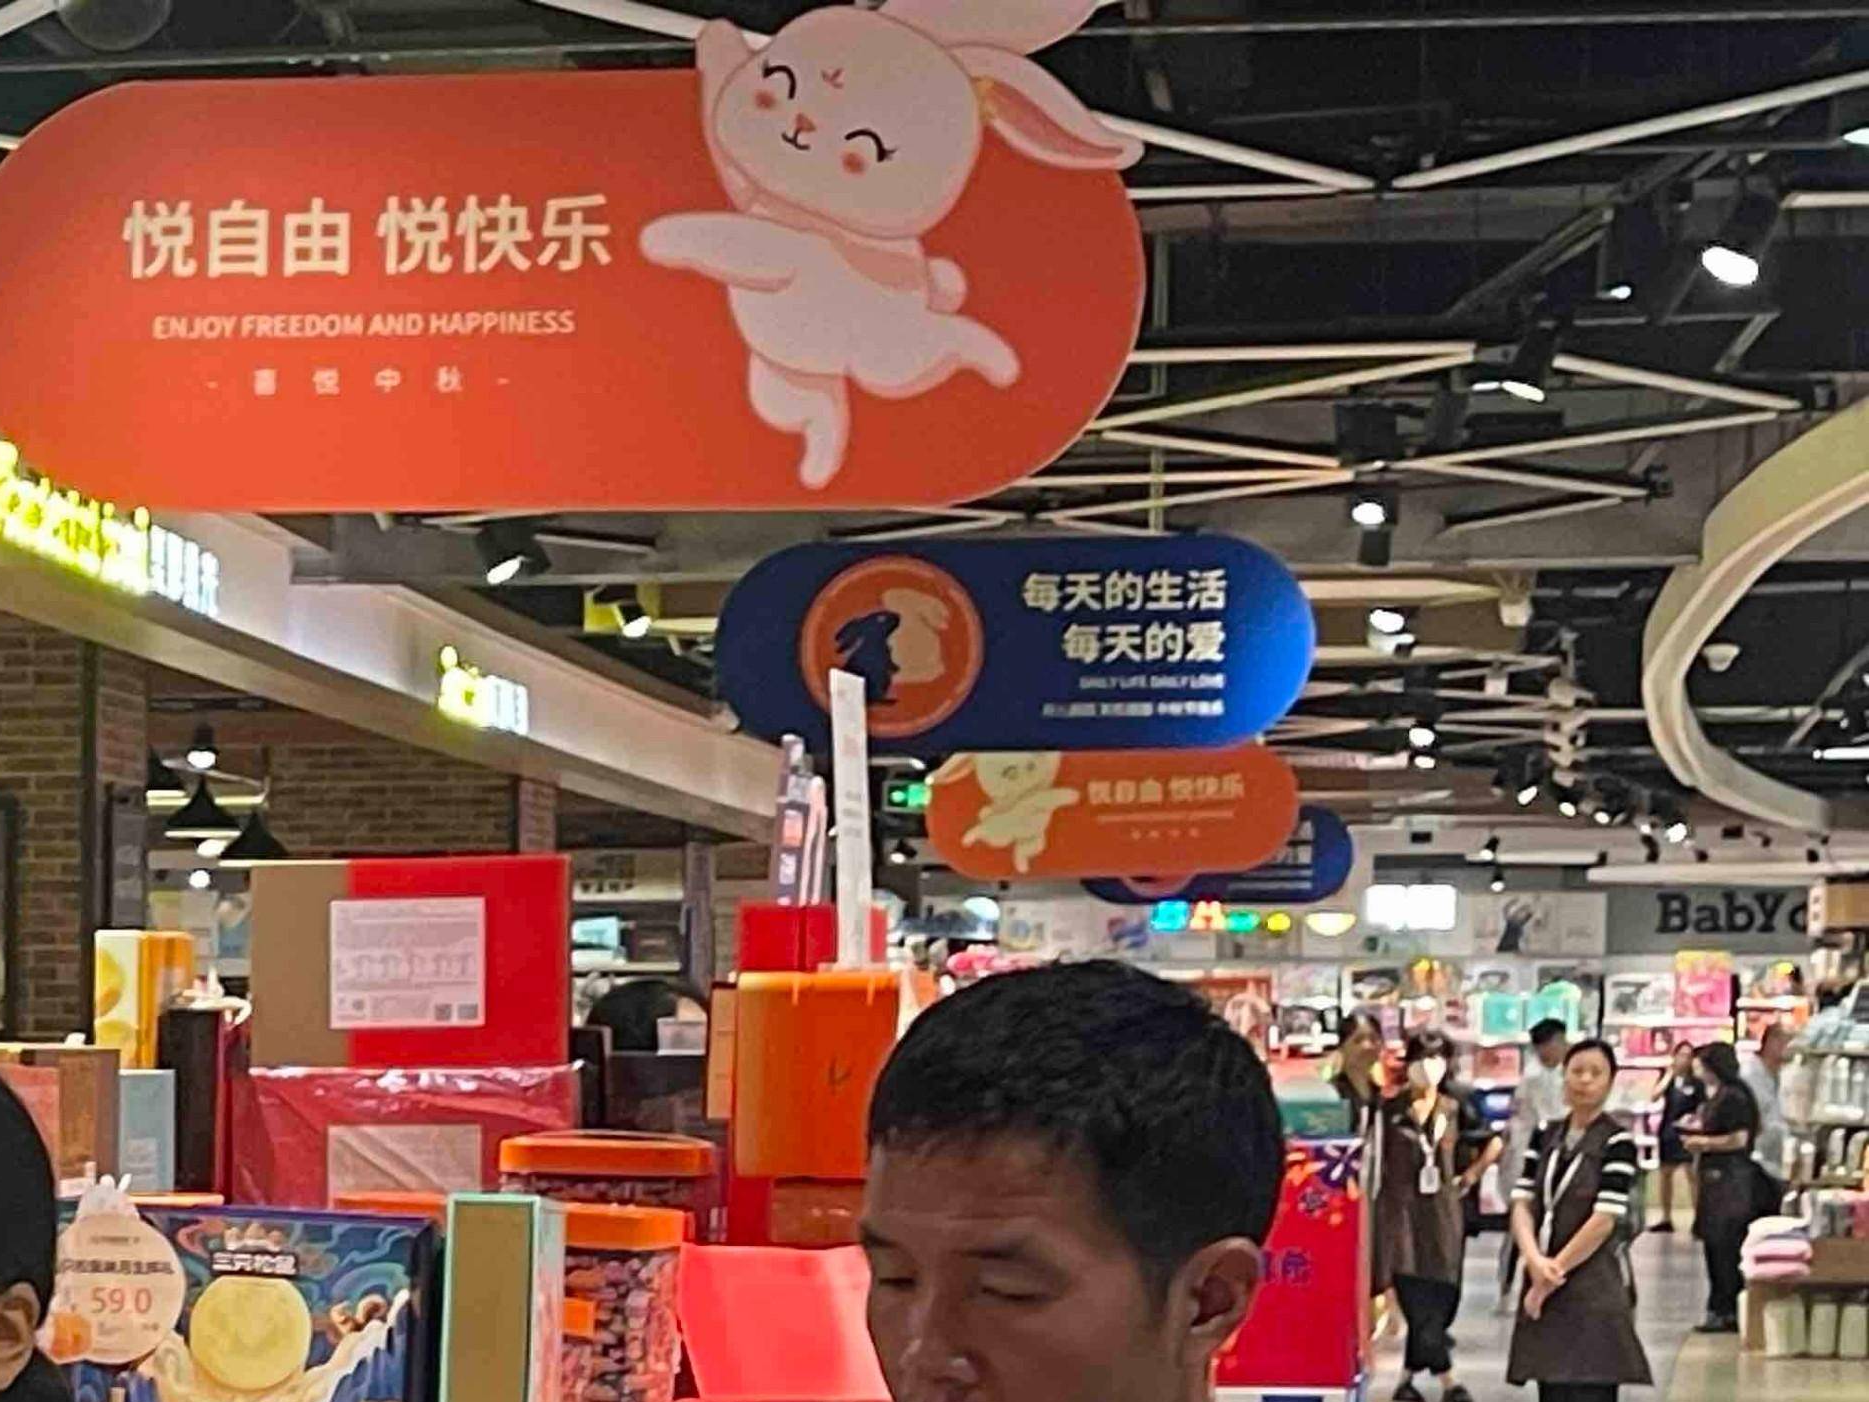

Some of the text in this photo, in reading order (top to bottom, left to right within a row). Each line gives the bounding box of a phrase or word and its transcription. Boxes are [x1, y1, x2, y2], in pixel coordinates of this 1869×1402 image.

[123, 194, 612, 278] 悦自由 悦快乐
[152, 309, 576, 340] ENJOY FREEDOM AND HAPPINESS
[1022, 569, 1227, 611] 每天的生活
[1062, 621, 1226, 663] 每天的爱
